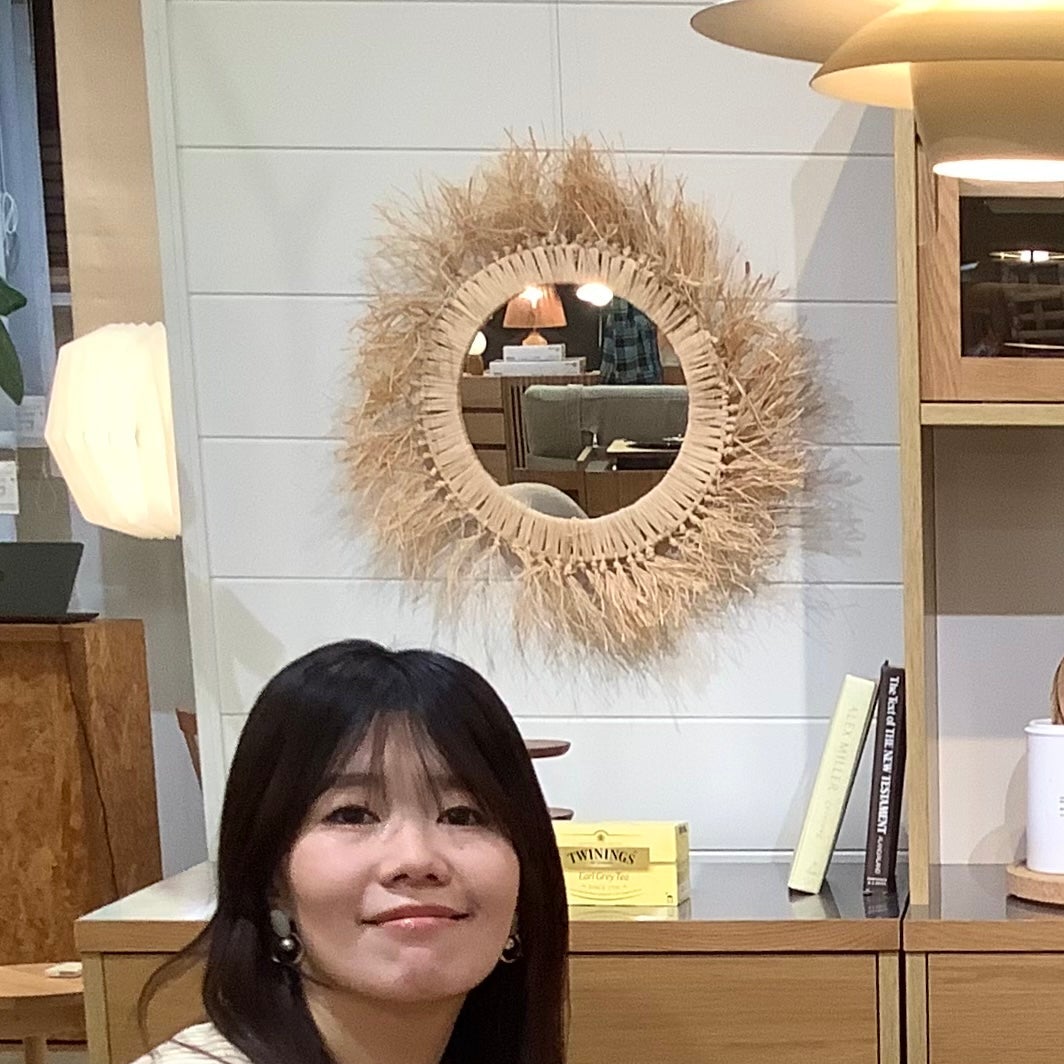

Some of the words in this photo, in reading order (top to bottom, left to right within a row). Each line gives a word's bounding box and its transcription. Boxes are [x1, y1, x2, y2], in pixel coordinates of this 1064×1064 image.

[888, 675, 900, 696] The
[886, 696, 899, 715] Text
[885, 715, 896, 727] of
[884, 728, 896, 749] THE
[882, 750, 894, 773] NEW
[876, 775, 892, 835] TESTAMENT
[566, 847, 637, 865] TWININGS
[578, 871, 596, 881] Earl
[596, 871, 614, 882] Grey
[615, 871, 630, 881] Tea
